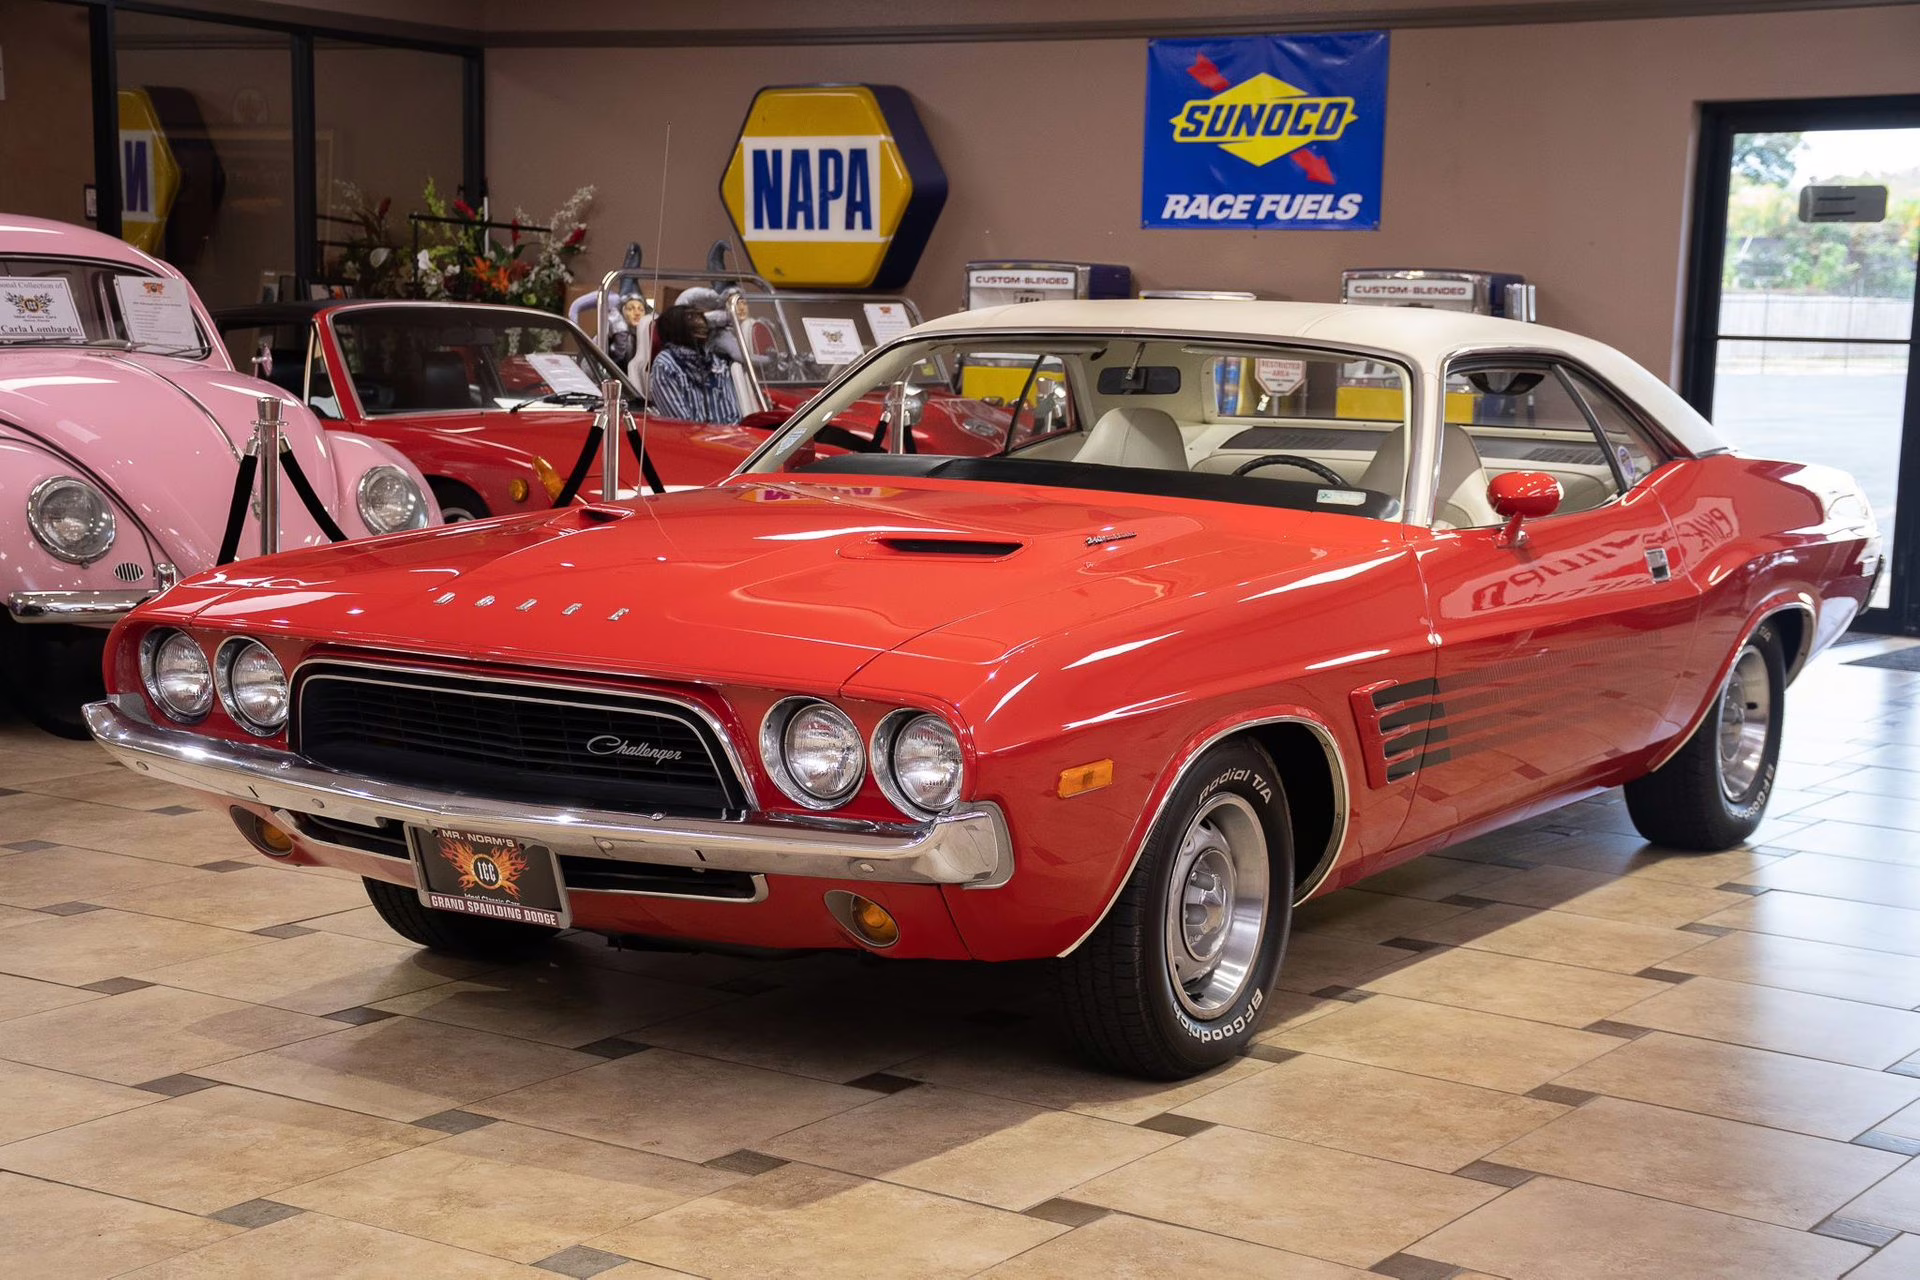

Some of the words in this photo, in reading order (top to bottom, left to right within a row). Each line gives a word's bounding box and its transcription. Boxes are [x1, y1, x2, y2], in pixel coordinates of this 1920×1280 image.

[1179, 102, 1349, 138] SUNOCO
[752, 148, 873, 231] NAPA
[1161, 194, 1256, 221] RACE
[1256, 193, 1363, 221] FUELS
[0, 325, 28, 333] Carla
[30, 325, 78, 333] Lombardo
[587, 735, 682, 765] Challenger
[1198, 768, 1251, 805] Radial
[1252, 774, 1272, 804] T/A
[442, 829, 464, 841] MR.
[467, 833, 515, 848] NORM'S
[478, 861, 496, 882] ICC
[431, 895, 465, 911] GRAND
[468, 901, 522, 920] SPAULDING
[525, 910, 557, 926] DODGE
[1173, 988, 1263, 1043] BFGoodrich
